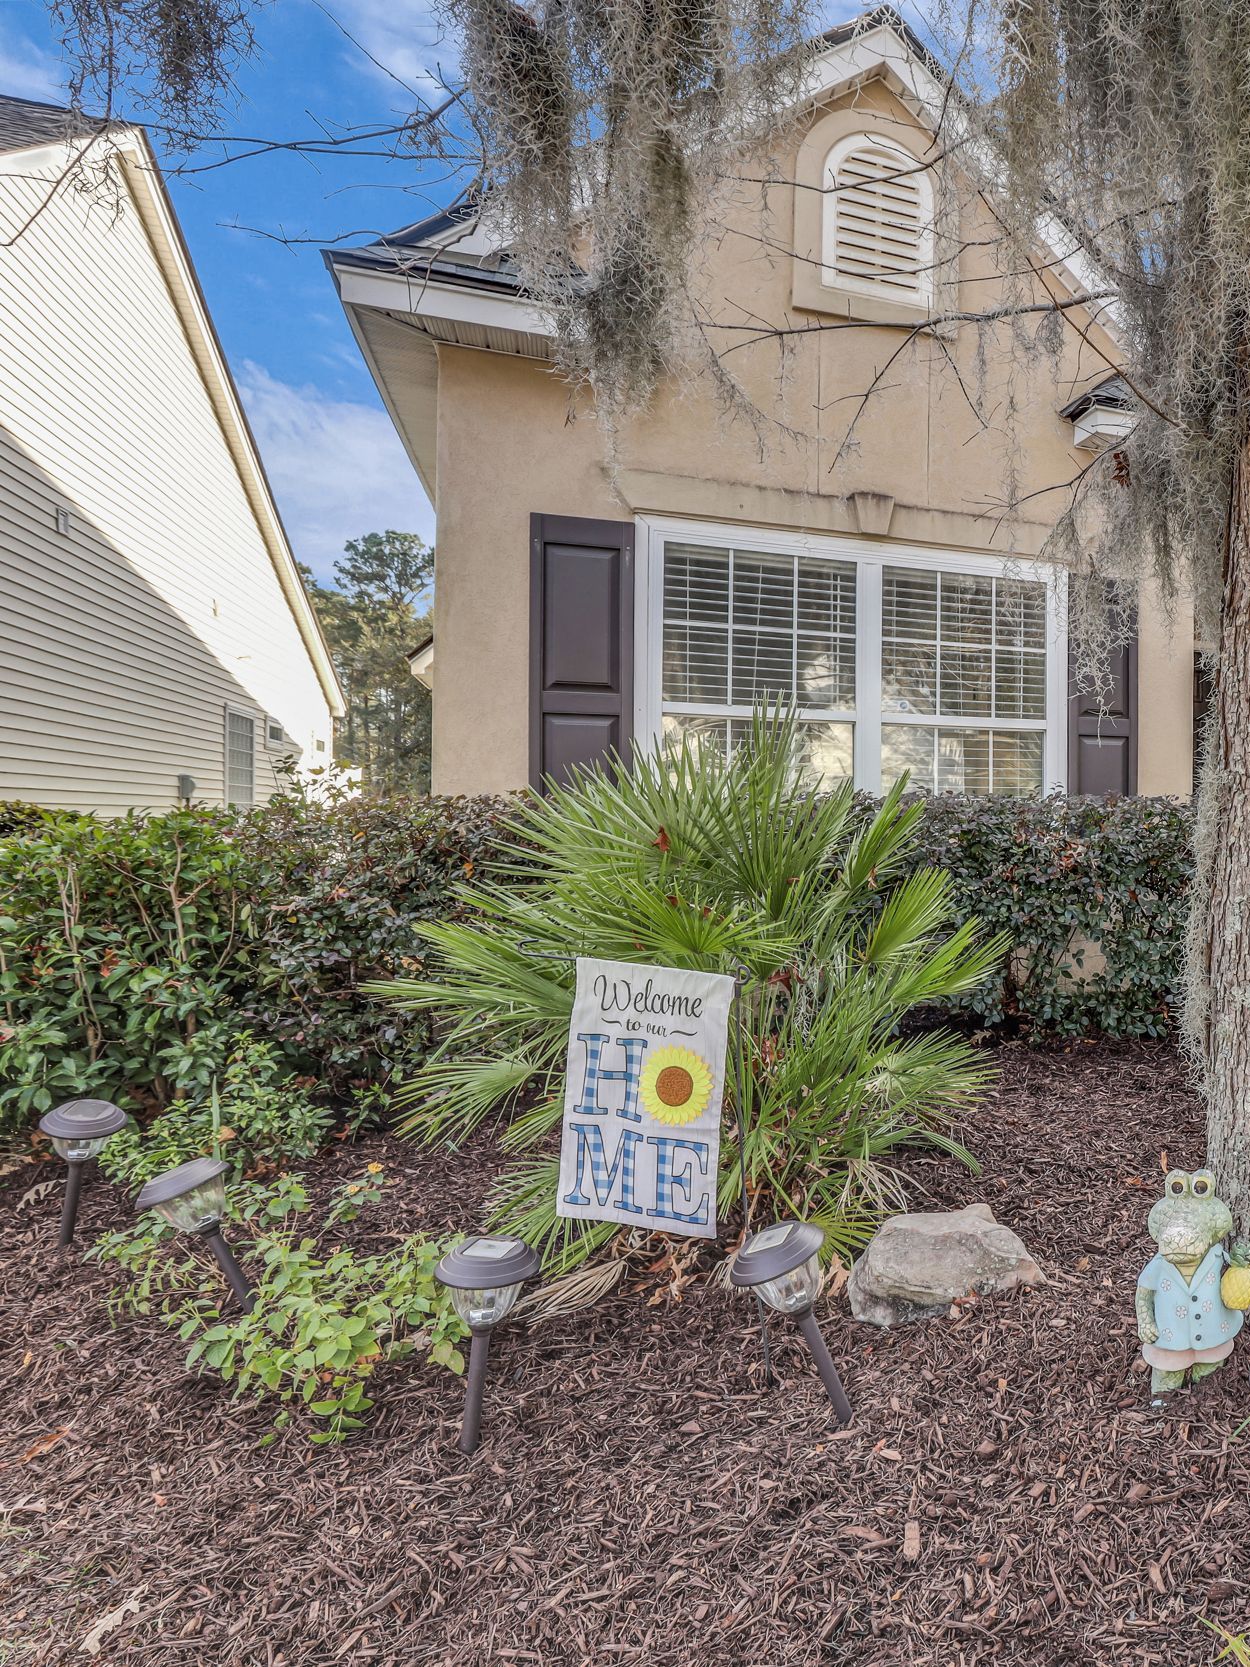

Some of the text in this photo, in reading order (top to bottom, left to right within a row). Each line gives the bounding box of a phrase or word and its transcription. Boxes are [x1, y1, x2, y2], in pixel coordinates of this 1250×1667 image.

[593, 974, 703, 1019] Welcome
[626, 1018, 668, 1037] to our
